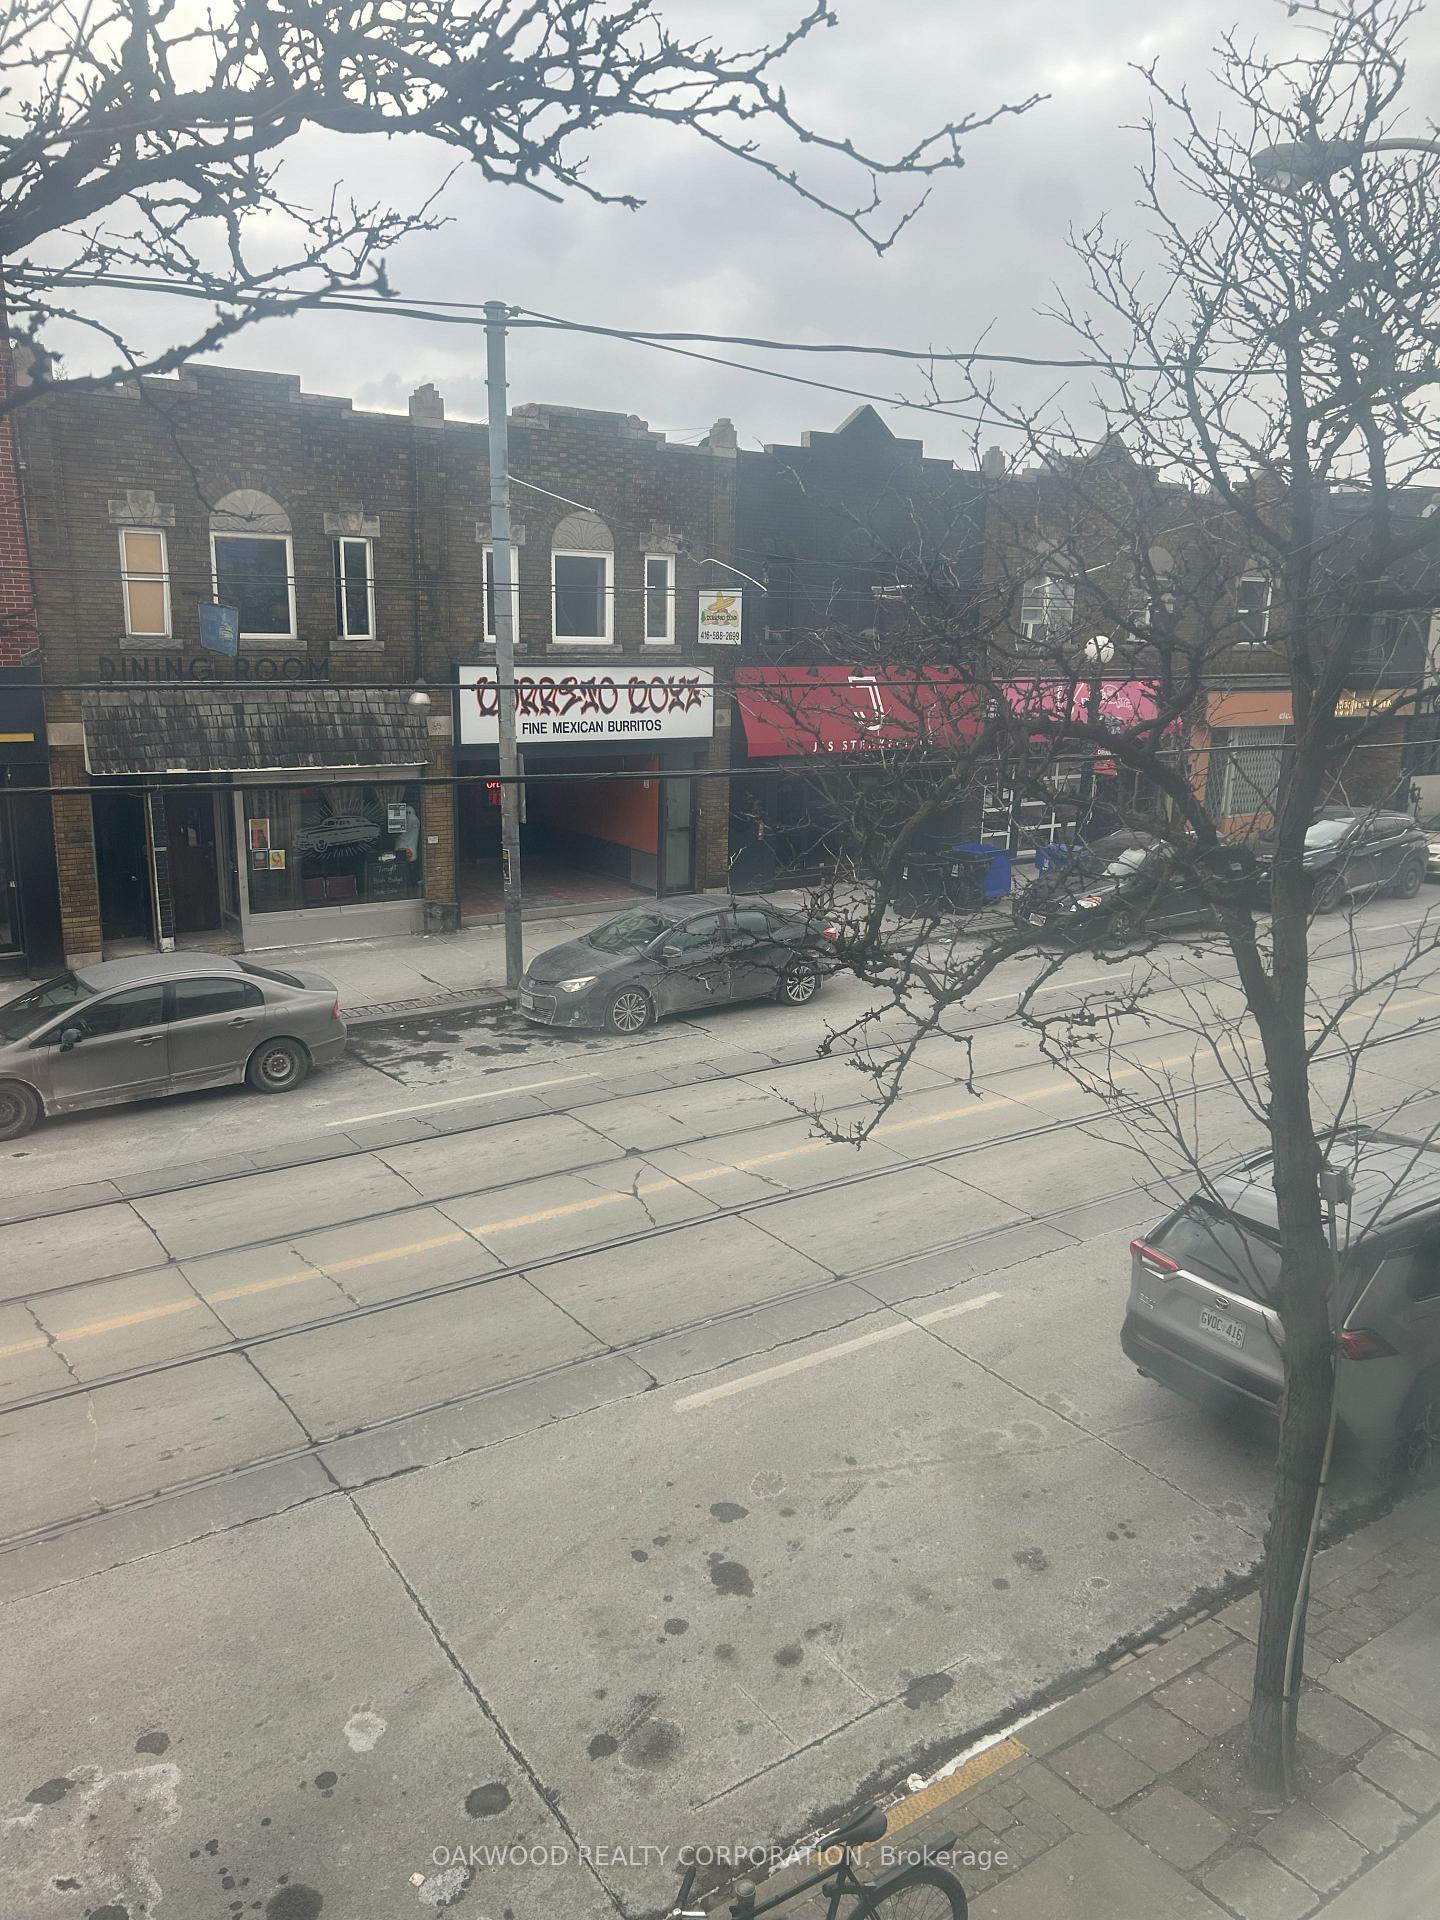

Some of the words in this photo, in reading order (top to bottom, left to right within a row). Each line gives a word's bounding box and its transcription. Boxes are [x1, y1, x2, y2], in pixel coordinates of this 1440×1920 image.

[99, 656, 212, 681] DINING
[234, 656, 330, 681] ROOM
[476, 676, 618, 717] BRRITO
[522, 722, 548, 735] FINE
[552, 721, 604, 734] MEXICAN
[608, 719, 662, 733] BURRITOS
[1225, 1324, 1243, 1341] 416
